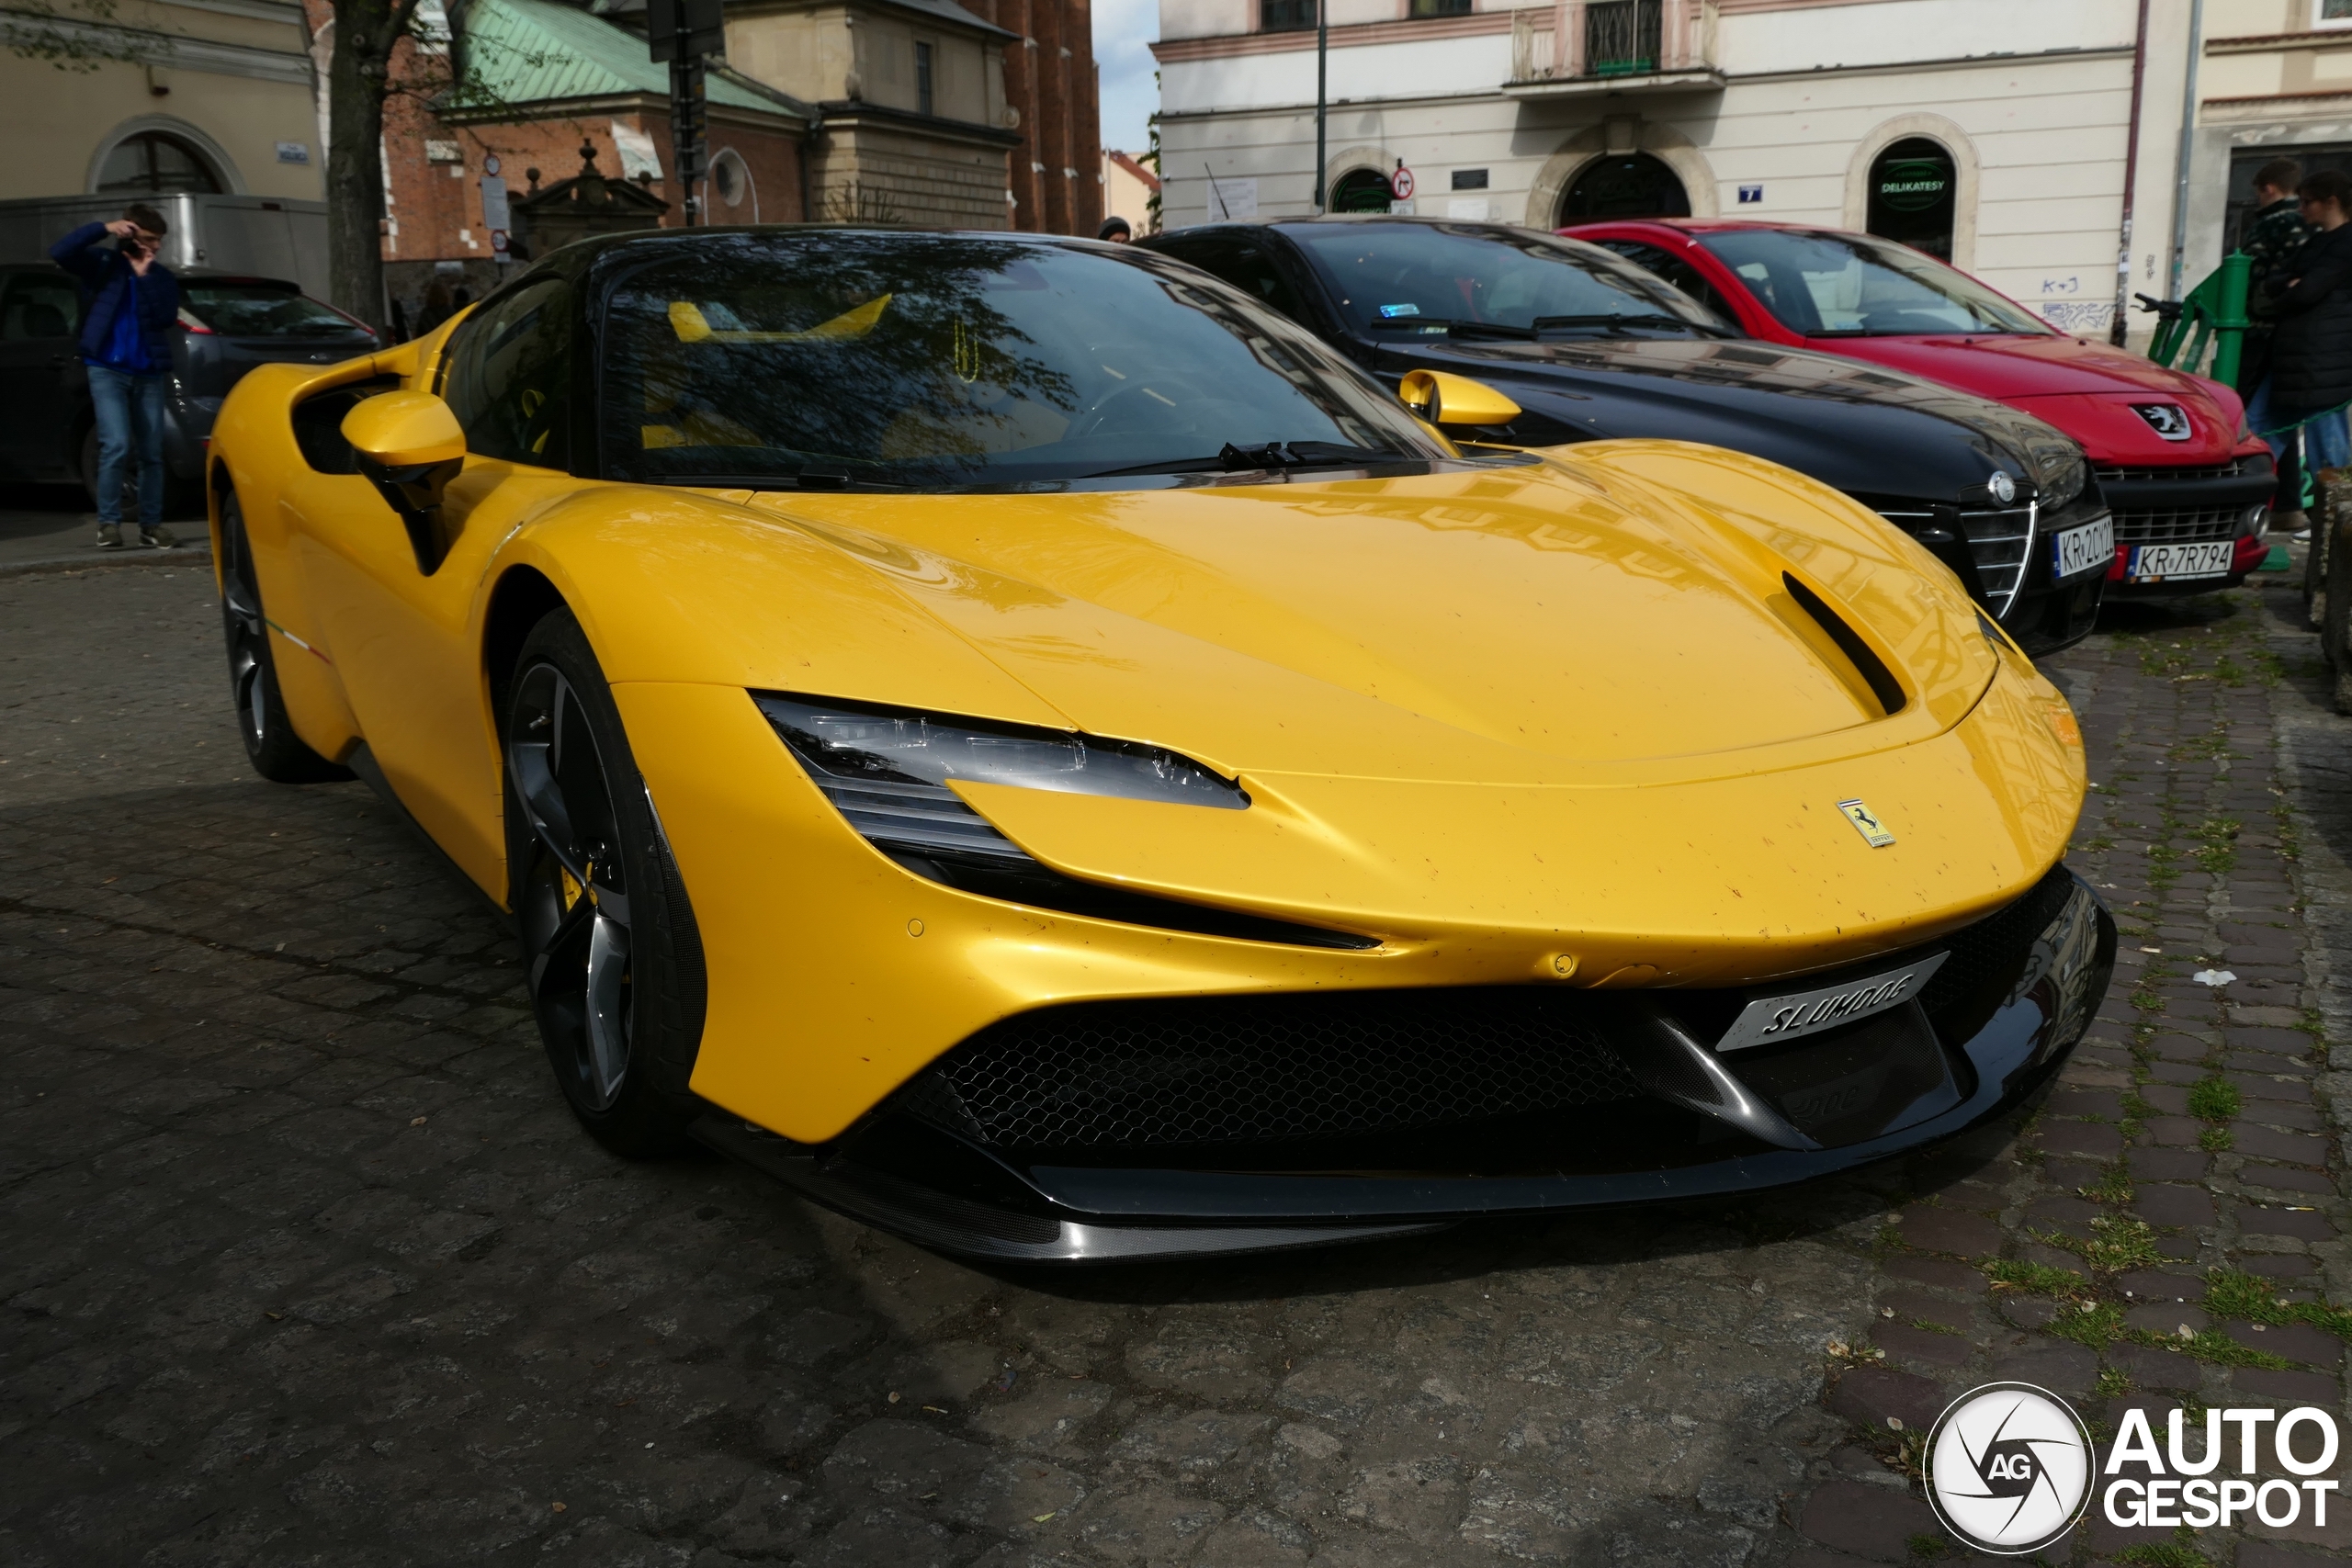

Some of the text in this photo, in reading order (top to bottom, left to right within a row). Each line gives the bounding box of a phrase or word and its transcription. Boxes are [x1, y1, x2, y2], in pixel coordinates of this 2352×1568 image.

[1746, 189, 1755, 202] 7
[1881, 180, 1945, 194] DELIKATESY
[2064, 533, 2082, 571] KR
[2140, 544, 2230, 573] KR 7R794
[1762, 974, 1914, 1034] SLUMDOG
